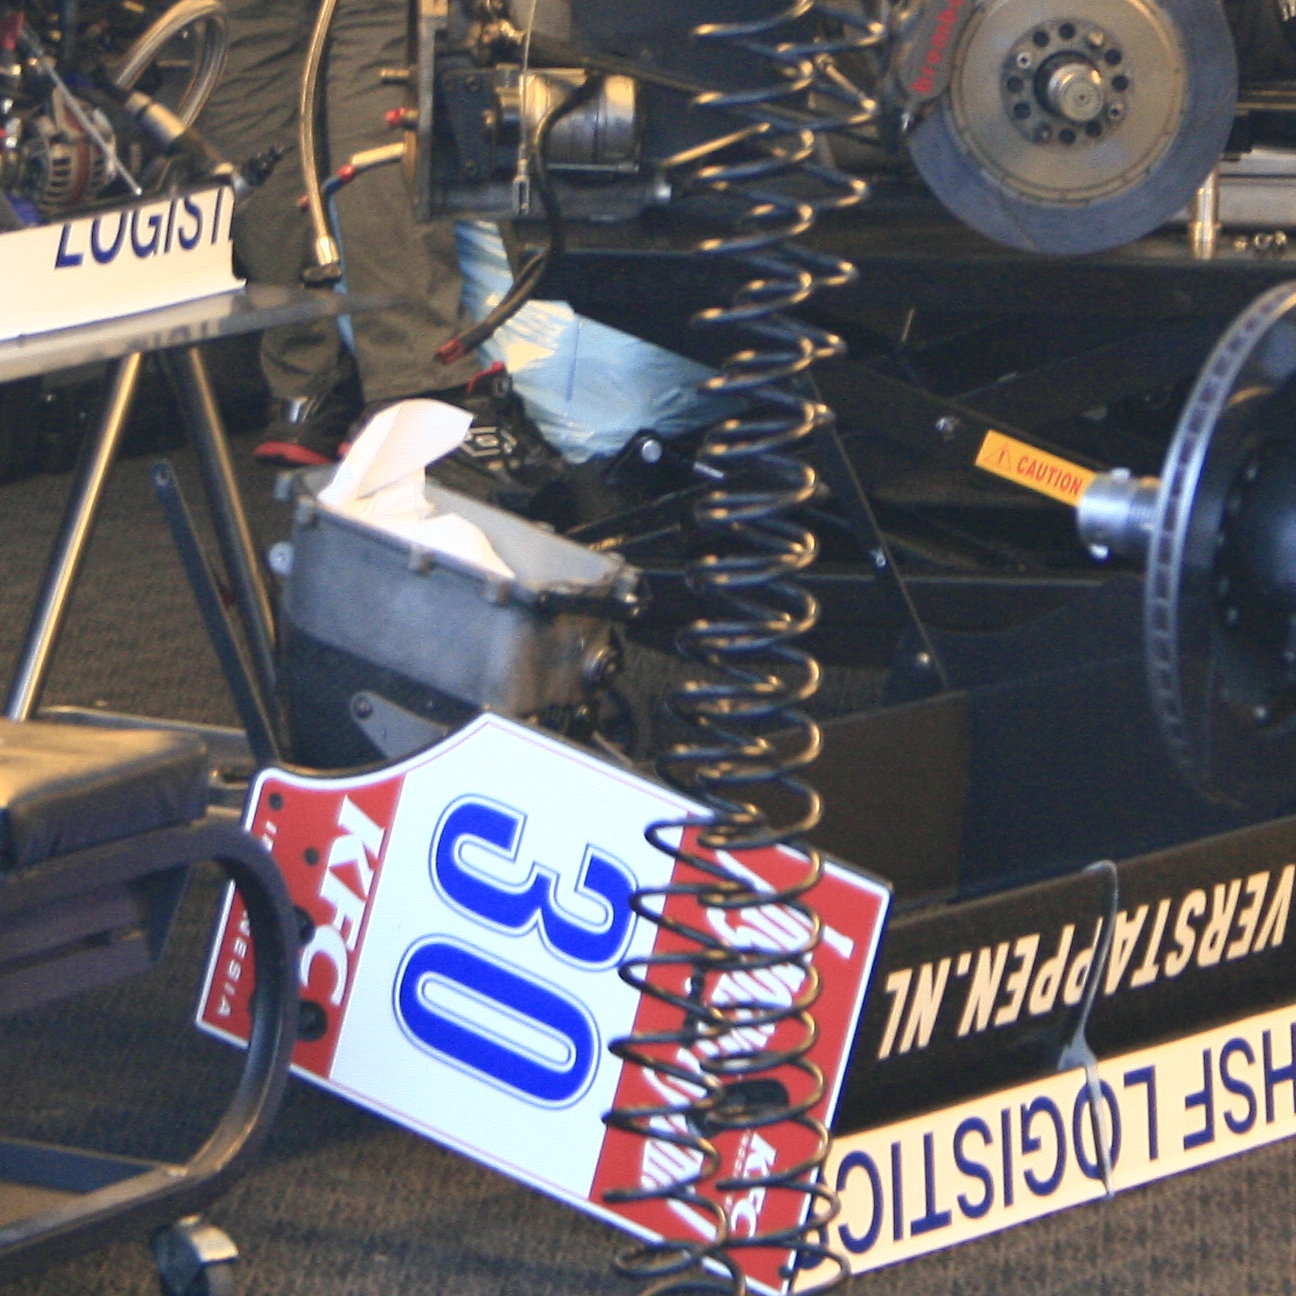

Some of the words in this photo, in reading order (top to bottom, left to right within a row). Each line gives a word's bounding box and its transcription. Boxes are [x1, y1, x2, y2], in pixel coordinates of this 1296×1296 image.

[1017, 455, 1083, 495] CAUTION
[299, 794, 386, 1008] KFC
[391, 793, 640, 1111] 30
[877, 864, 1296, 1060] VERSTAPPEN.NL
